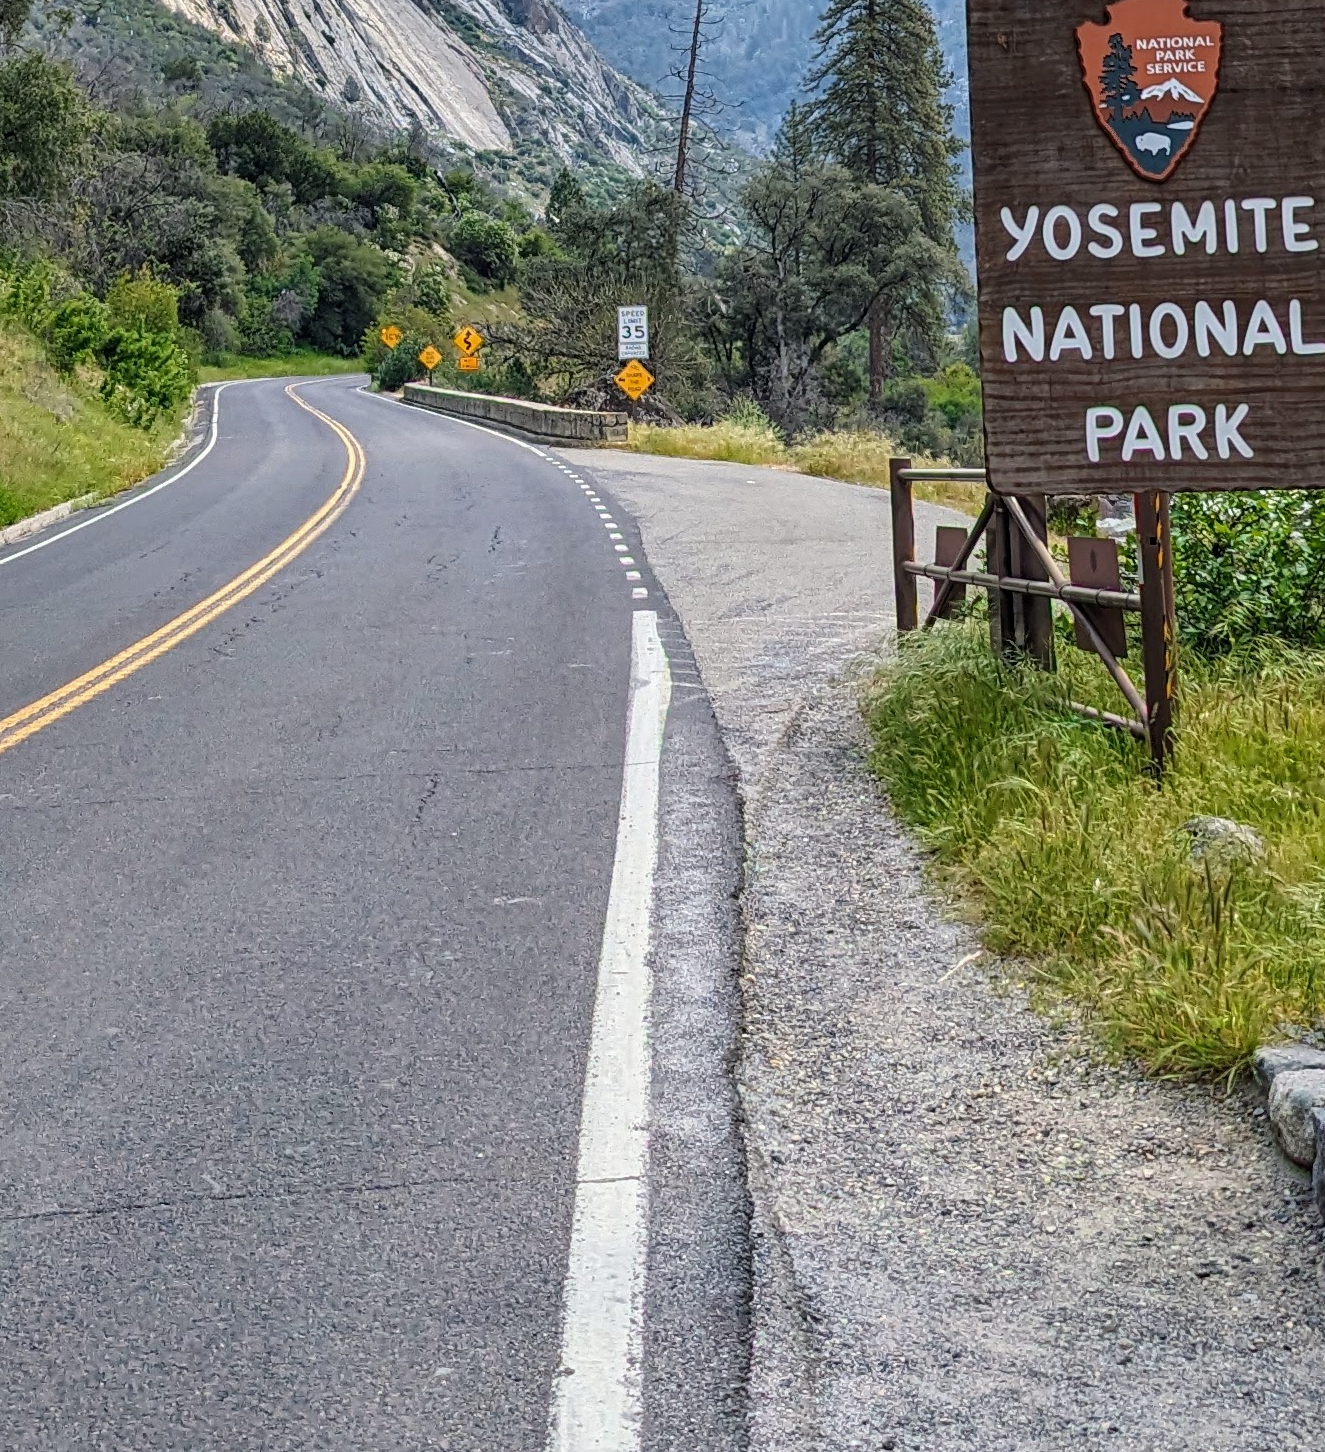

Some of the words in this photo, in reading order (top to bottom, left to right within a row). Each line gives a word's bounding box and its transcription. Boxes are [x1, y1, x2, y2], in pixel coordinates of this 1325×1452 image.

[1136, 36, 1214, 50] NATIONAL
[1156, 49, 1195, 61] PARK
[1146, 61, 1206, 75] SERVICE
[1000, 196, 1319, 262] YOSEMITE
[621, 325, 645, 339] 35
[1086, 403, 1254, 463] PARK
